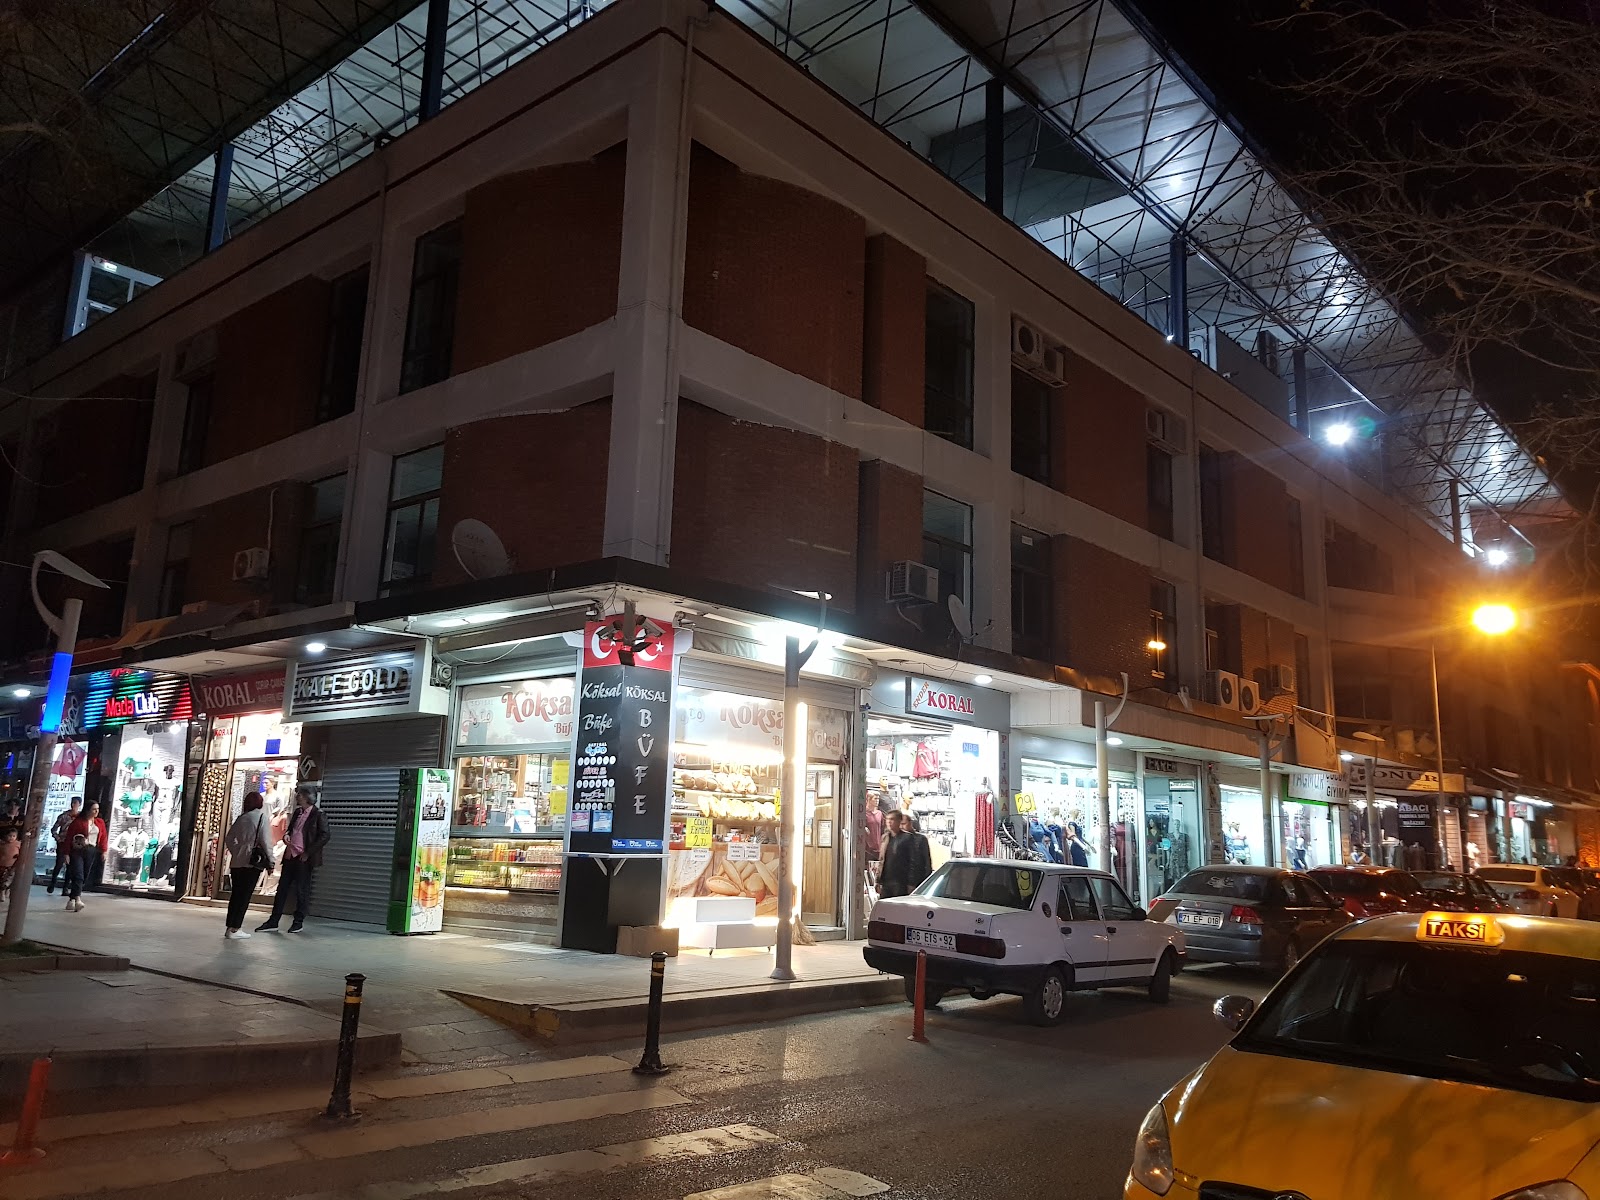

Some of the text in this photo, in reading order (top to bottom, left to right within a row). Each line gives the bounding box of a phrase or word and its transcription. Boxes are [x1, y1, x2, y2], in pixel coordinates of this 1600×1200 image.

[296, 673, 341, 698] KALE
[348, 668, 400, 693] GOLD
[581, 682, 623, 699] Köksal
[625, 685, 668, 703] KÖKSAL
[106, 692, 159, 717] Moda Club
[203, 682, 255, 709] KORAL
[501, 689, 574, 723] Köksa
[927, 690, 974, 714] KORAL
[582, 713, 613, 735] Büfe
[1017, 795, 1032, 813] 29
[924, 932, 938, 944] ETS
[943, 935, 953, 946] 92
